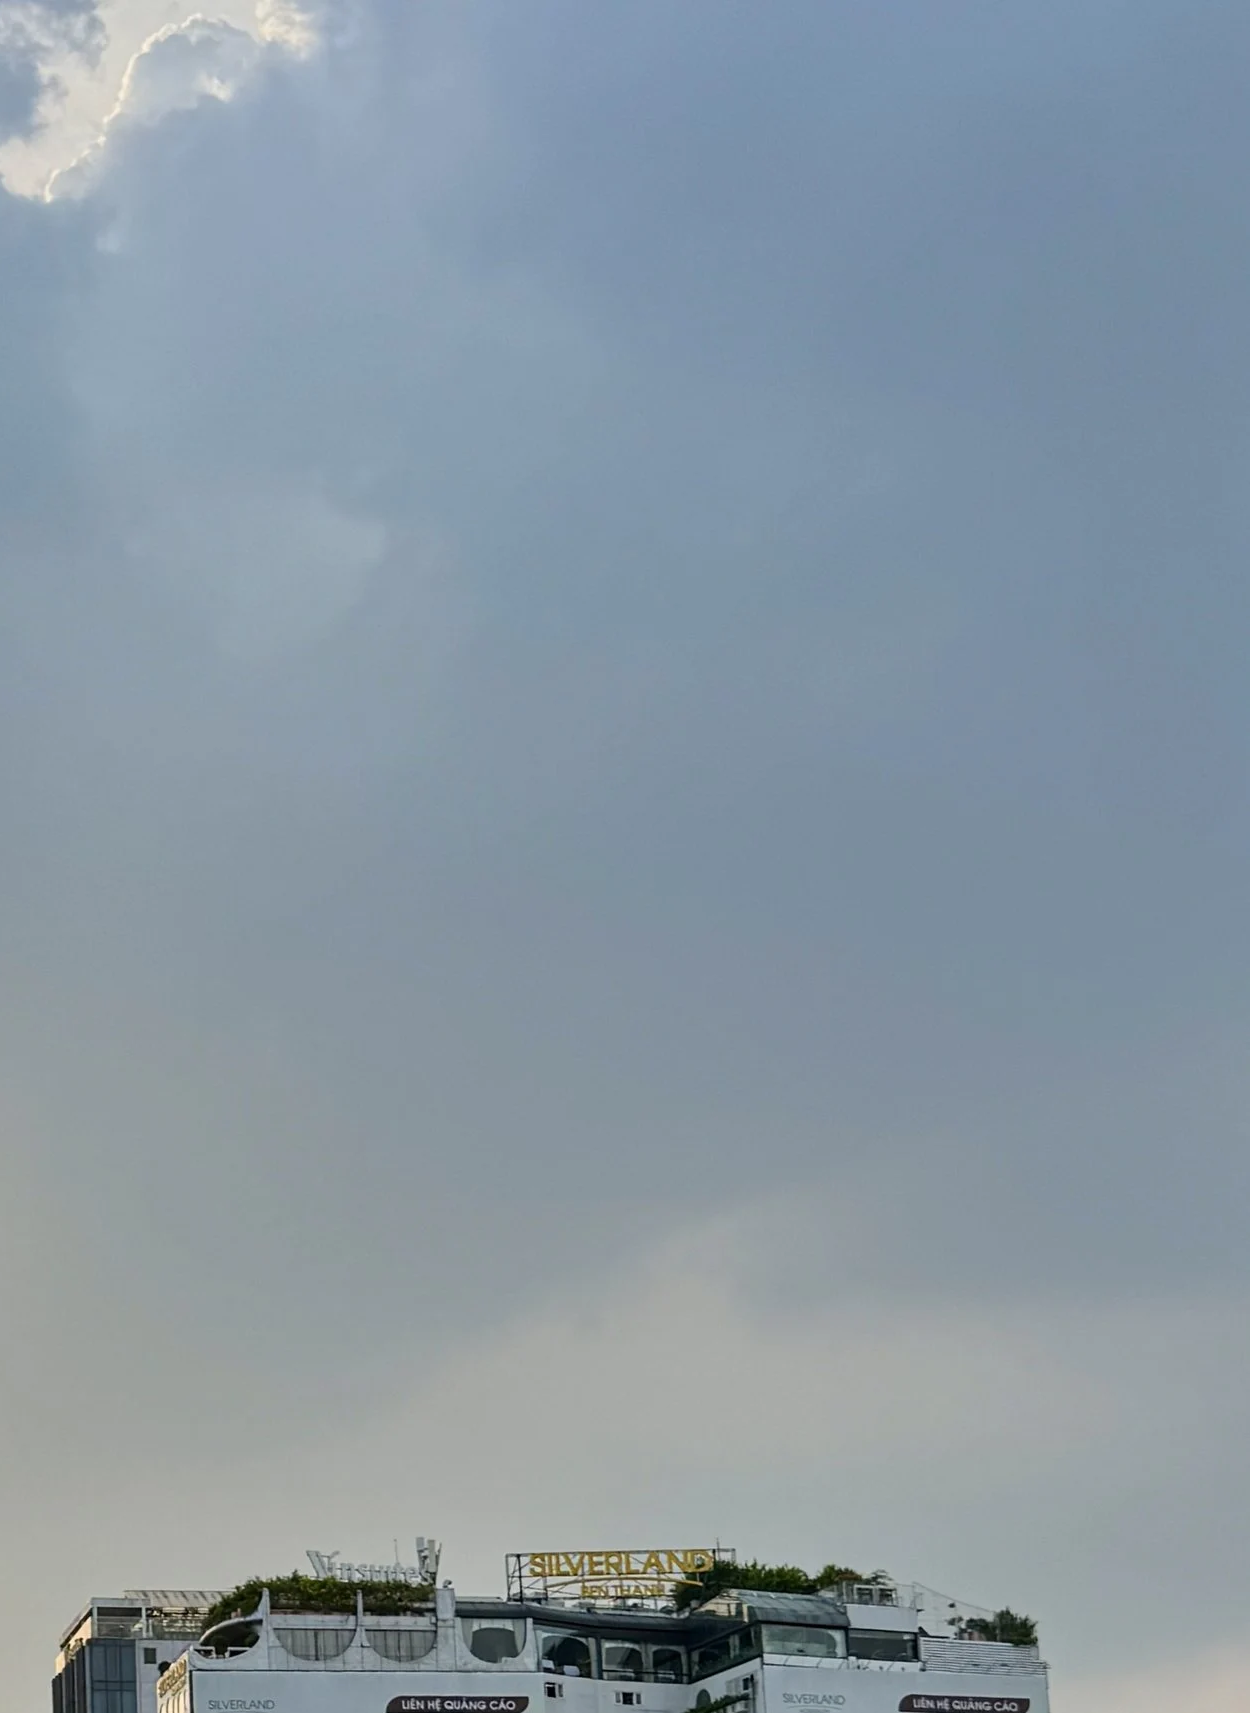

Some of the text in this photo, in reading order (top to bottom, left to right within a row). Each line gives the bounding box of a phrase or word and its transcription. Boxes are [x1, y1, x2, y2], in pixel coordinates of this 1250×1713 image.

[529, 1551, 715, 1576] SILVERLAND
[208, 1700, 275, 1710] SILVERLAND
[402, 1698, 425, 1710] LIÊN
[427, 1697, 442, 1712] HỆ
[489, 1698, 516, 1711] CÁO
[782, 1693, 846, 1706] SILVERLAND
